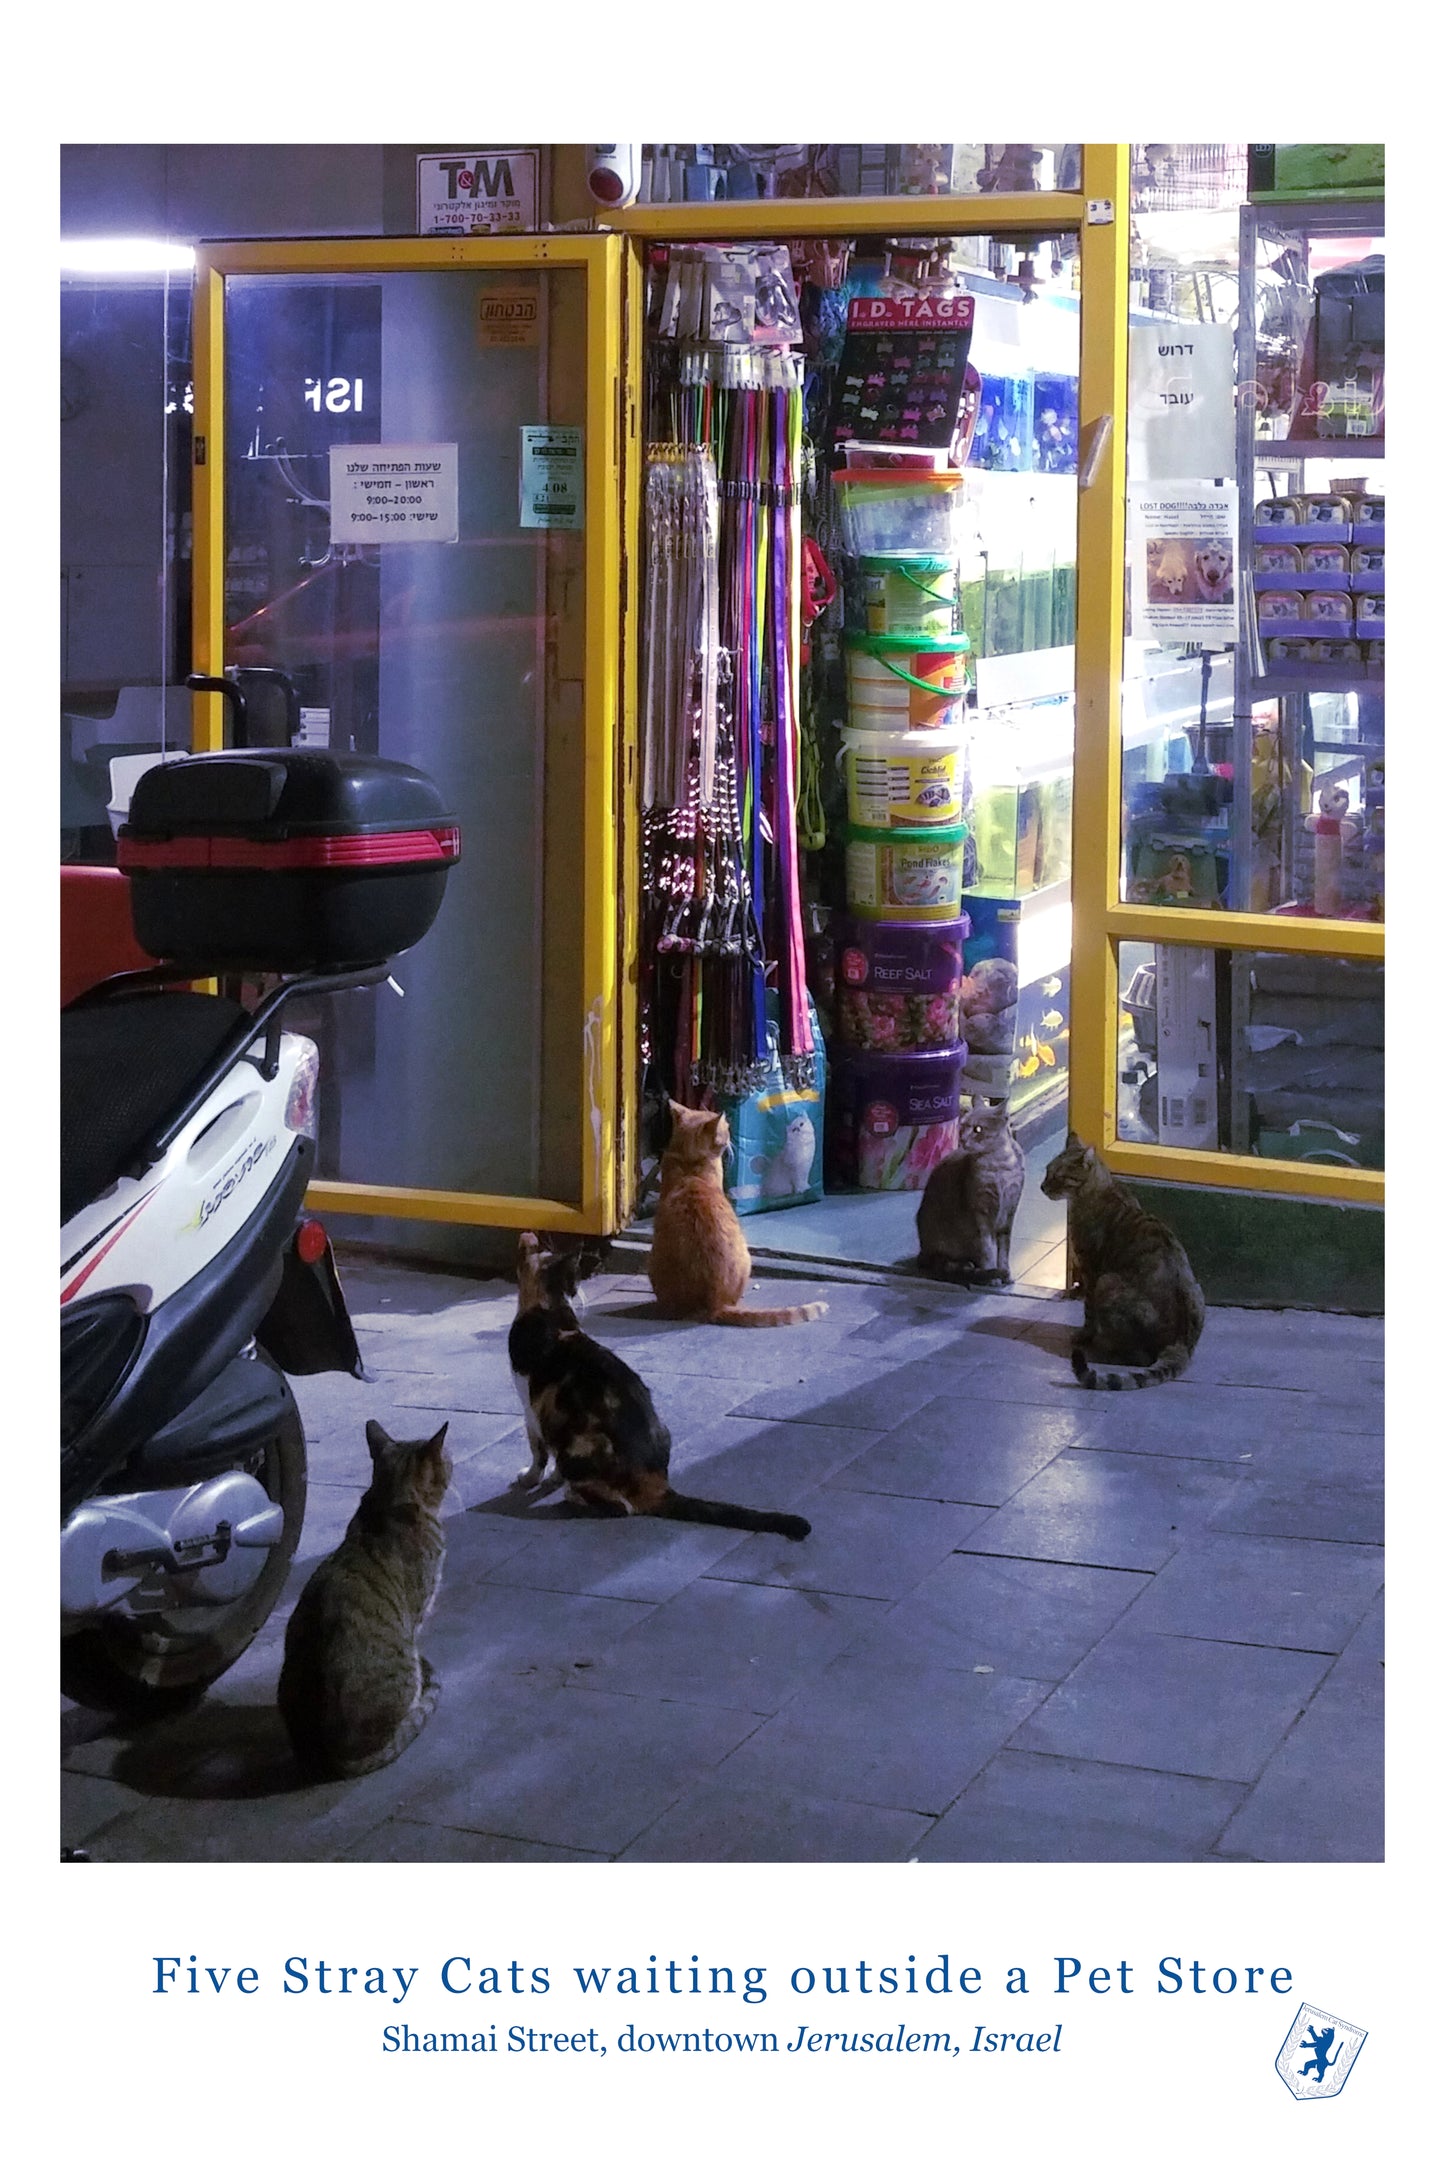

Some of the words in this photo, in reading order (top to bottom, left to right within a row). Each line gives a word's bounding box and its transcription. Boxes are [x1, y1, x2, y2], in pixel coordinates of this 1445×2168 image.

[439, 158, 515, 199] T&M
[434, 211, 521, 224] 1-700-70-33-33
[902, 300, 970, 317] TAGS
[898, 319, 919, 327] HERE
[922, 319, 969, 327] INSTANTLY
[1158, 345, 1194, 356] דרוש
[1160, 393, 1194, 405] עובד
[346, 462, 369, 473] שלנו
[372, 463, 411, 472] הפתיחה
[414, 462, 441, 471] שעות
[360, 480, 392, 489] חמישי
[405, 480, 435, 490] ראשון
[350, 512, 407, 523] 9:00-15:00
[901, 858, 924, 869] Pond
[874, 966, 903, 979] REEF
[905, 967, 932, 980] SALT
[910, 1098, 931, 1110] SEA
[932, 1096, 953, 1110] SALT
